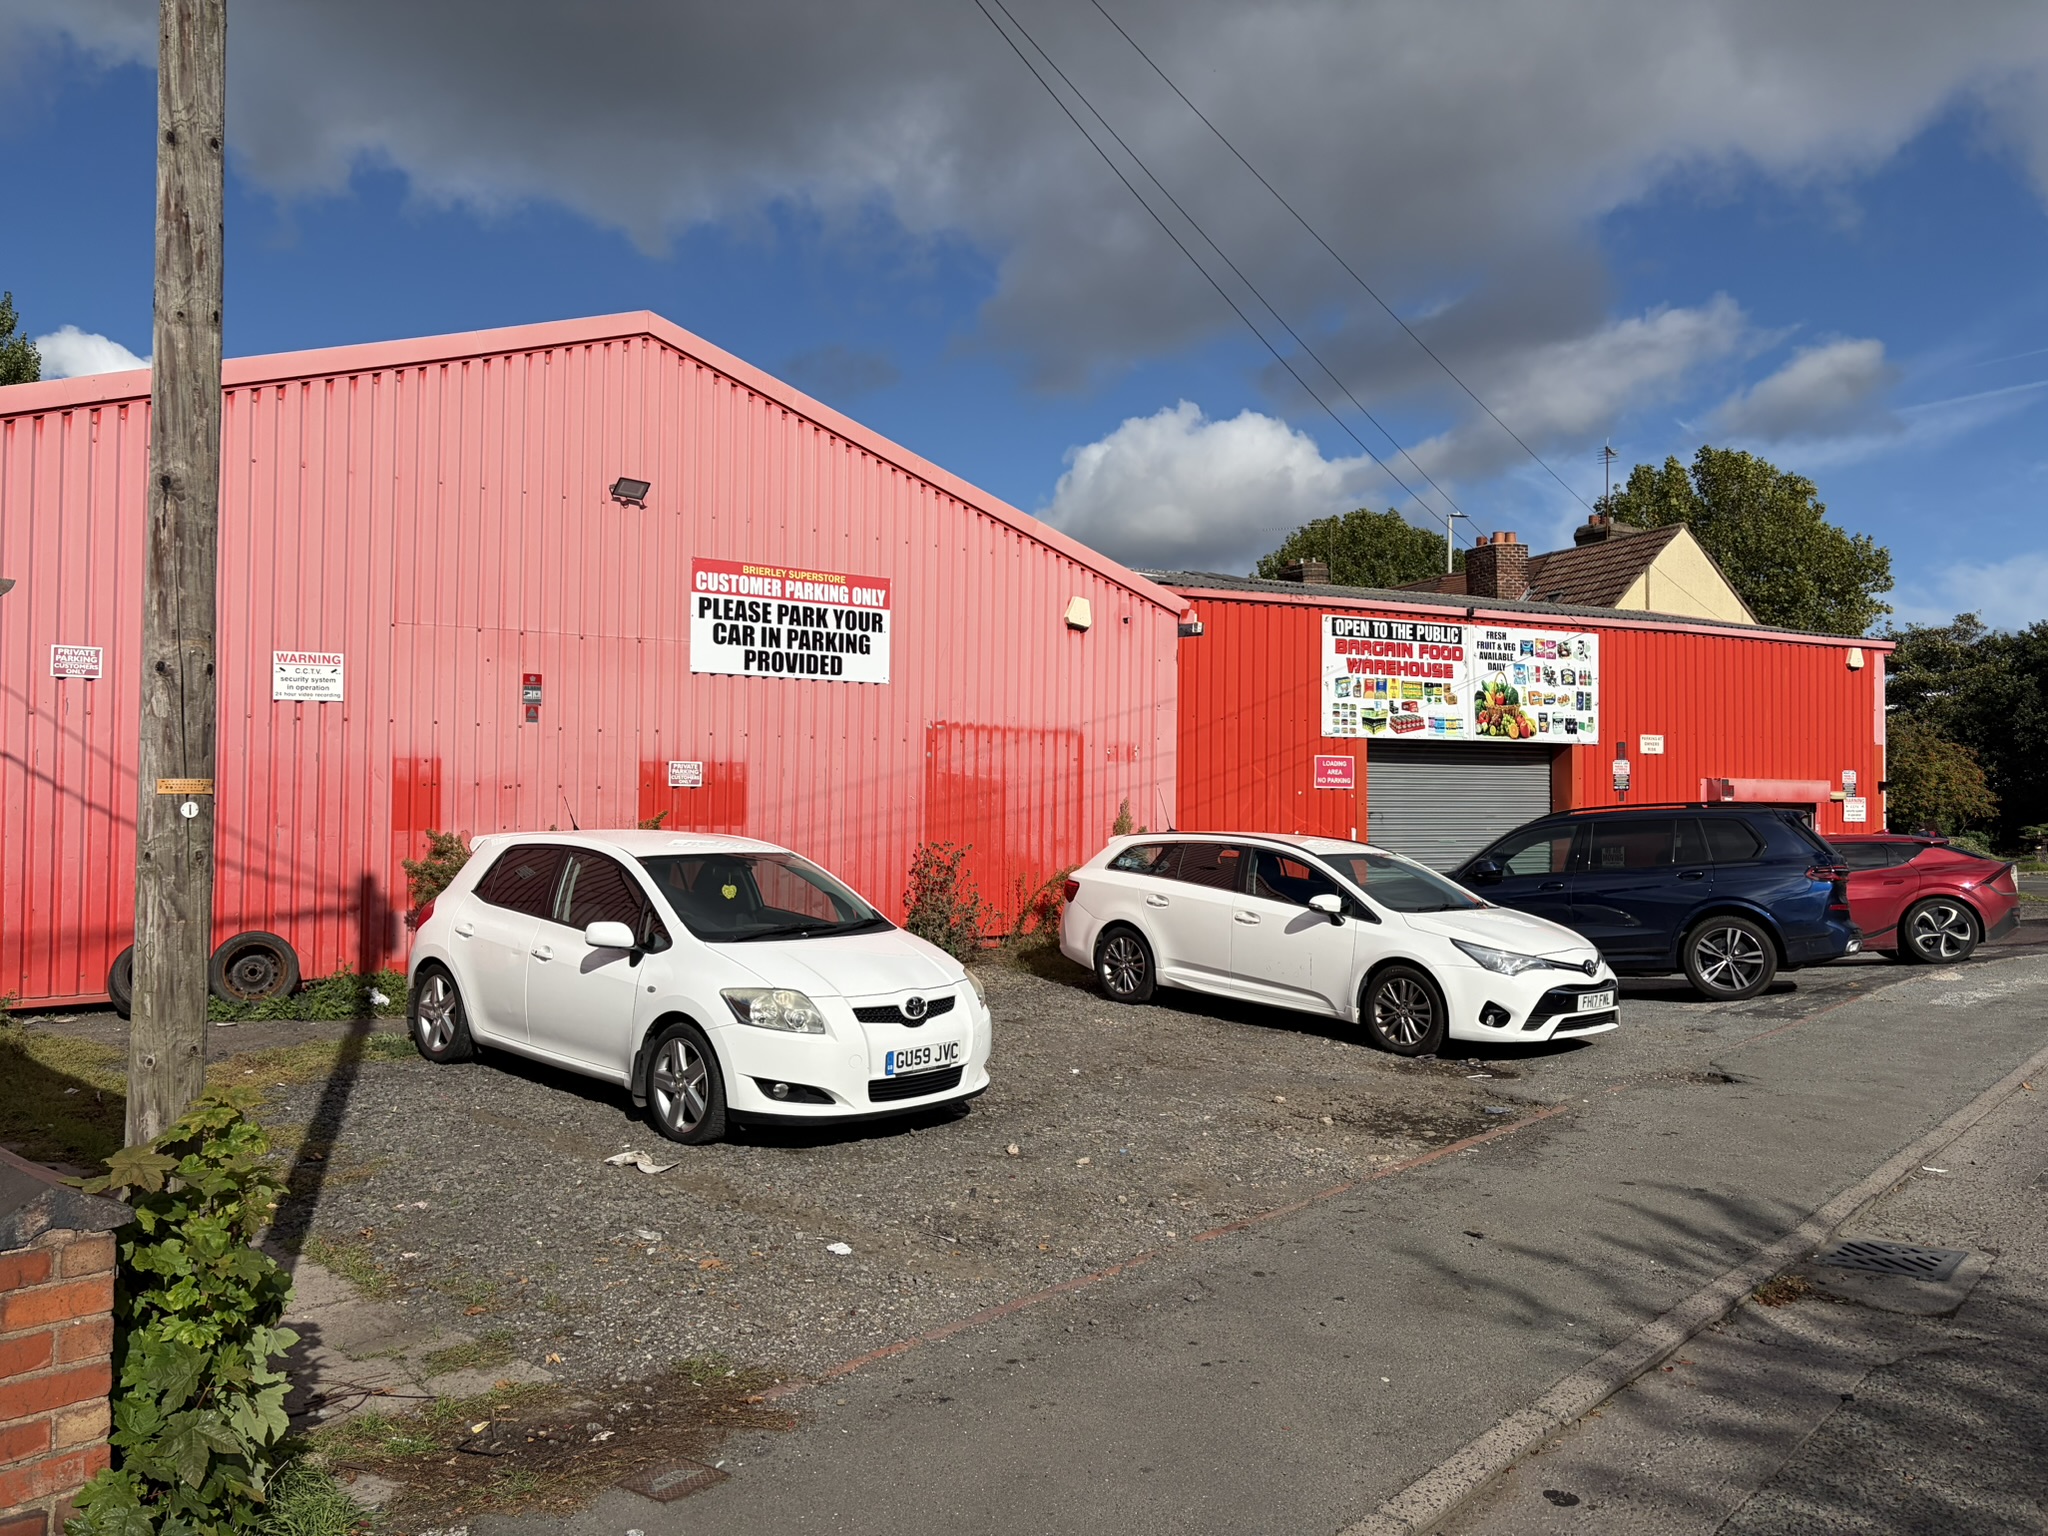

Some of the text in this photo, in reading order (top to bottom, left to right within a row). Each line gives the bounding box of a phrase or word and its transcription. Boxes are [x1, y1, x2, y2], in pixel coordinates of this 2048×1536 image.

[742, 565, 846, 584] BRIERLEY SUPERSTORE
[695, 570, 886, 607] CUSTOMER PARKING ONLY
[698, 596, 884, 633] PLEASE PARK YOUR
[1335, 618, 1459, 643] OPEN TO THE PUBLIC
[1486, 630, 1507, 640] FRESH
[712, 622, 871, 655] CAR IN PARKING
[1476, 640, 1496, 651] FRUIT
[1503, 642, 1516, 651] VEG
[57, 648, 96, 656] PRIVATE
[1334, 638, 1464, 662] BARGAIN FOOD
[1479, 651, 1514, 661] AVAILABLE
[54, 662, 99, 670] CUSTOMERS
[55, 654, 98, 663] PARKING
[276, 653, 341, 665] WARNING
[743, 649, 843, 676] PROVIDED
[1346, 657, 1454, 679] WAREHOUSE
[1487, 662, 1506, 672] DAILY
[280, 676, 309, 684] security
[1582, 994, 1599, 1009] FH17
[896, 1042, 959, 1069] GU59 JVC
